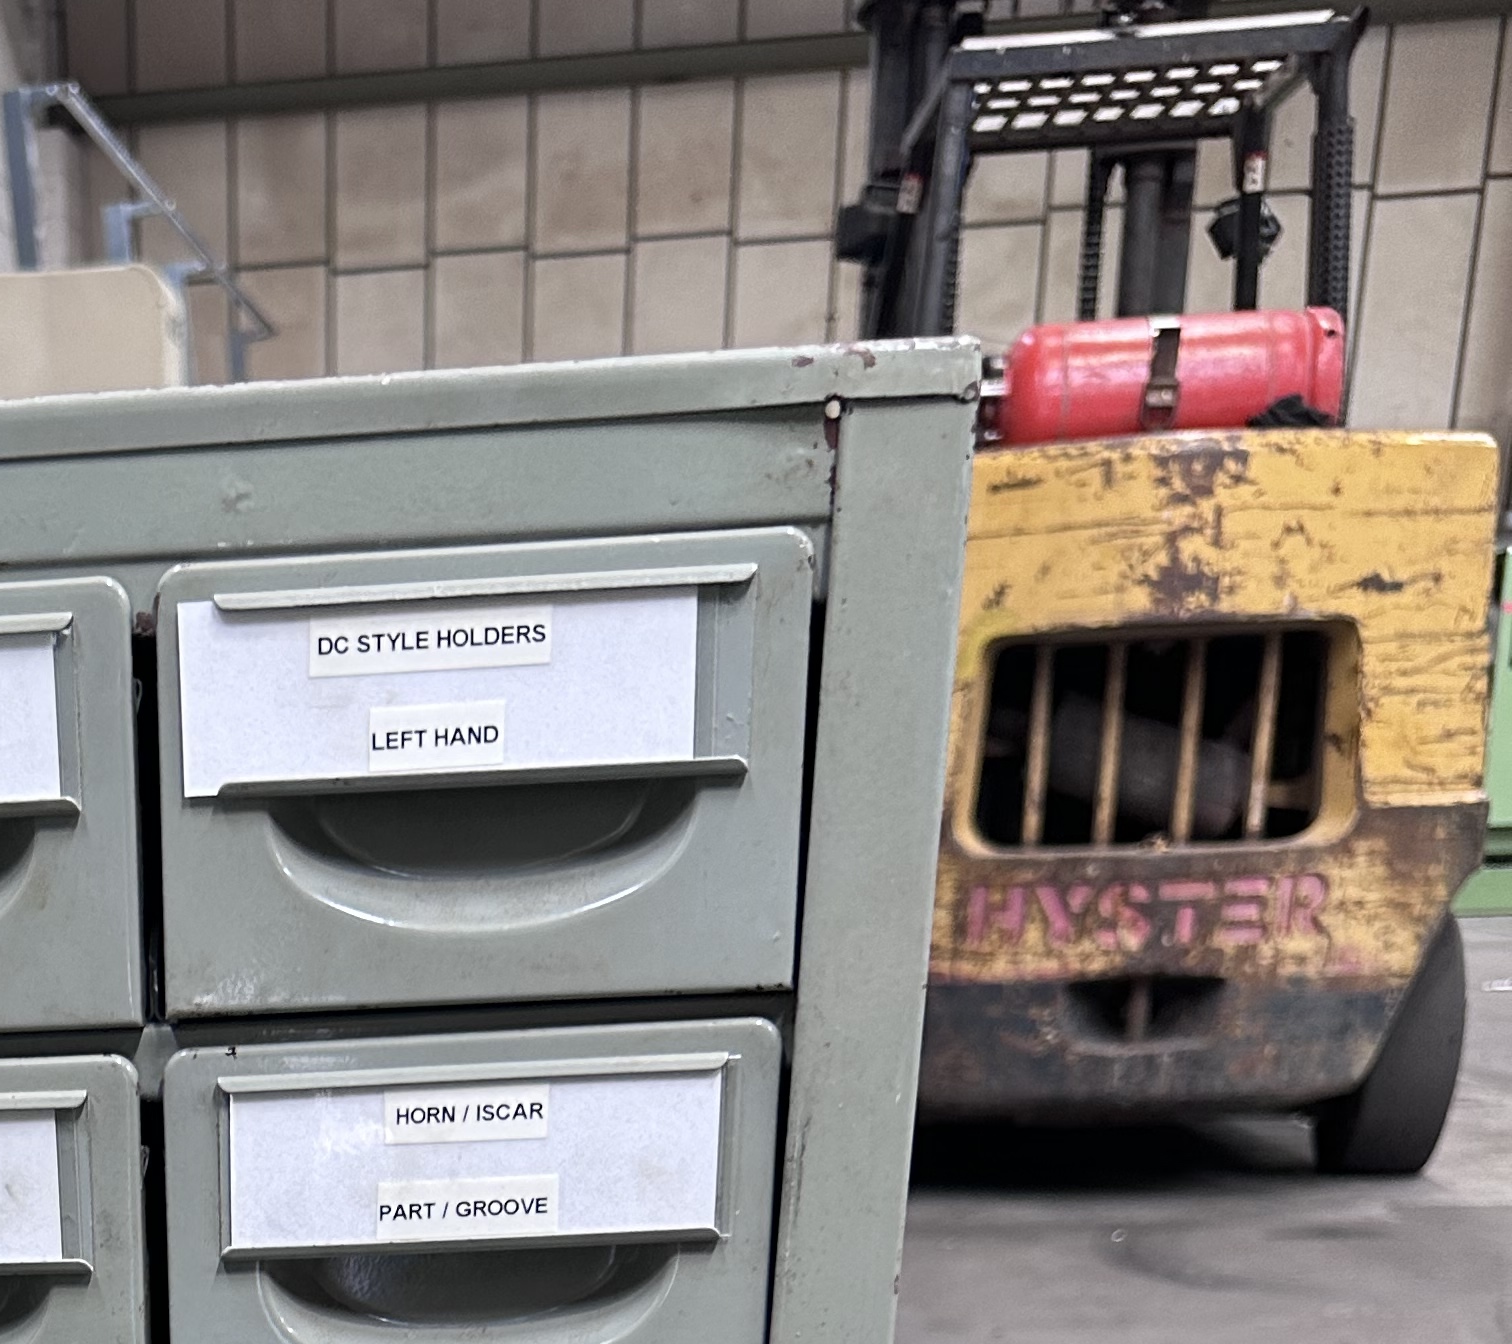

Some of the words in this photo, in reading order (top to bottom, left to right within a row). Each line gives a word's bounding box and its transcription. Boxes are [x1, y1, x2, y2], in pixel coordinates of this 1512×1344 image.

[317, 635, 350, 656] DC
[356, 630, 430, 653] STYLE
[436, 623, 547, 649] HOLDERS
[370, 728, 426, 751] LEFT
[433, 724, 500, 748] HAND
[962, 873, 1327, 952] HYSTER
[396, 1105, 456, 1126] HORN
[462, 1105, 469, 1123] /
[476, 1102, 544, 1122] ISCAR
[379, 1202, 436, 1222] PART
[441, 1202, 449, 1219] /
[455, 1197, 548, 1218] GROOVE
